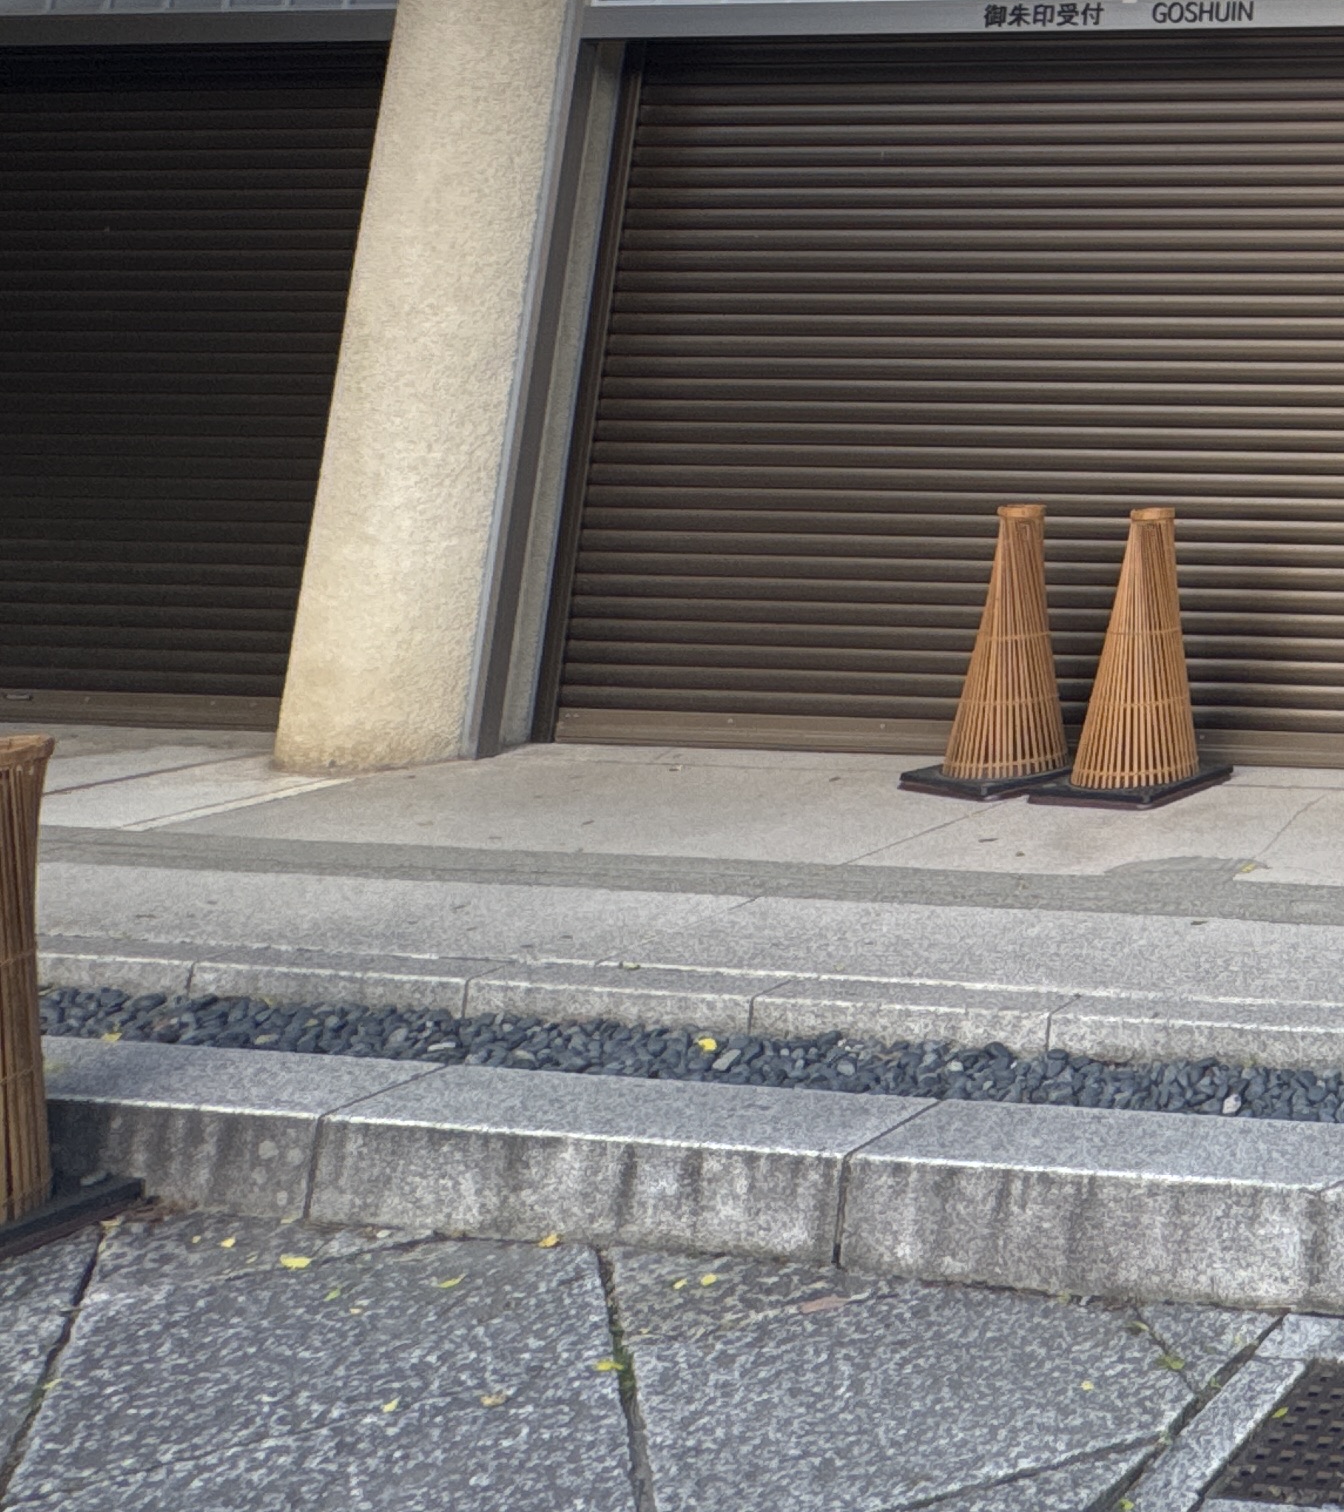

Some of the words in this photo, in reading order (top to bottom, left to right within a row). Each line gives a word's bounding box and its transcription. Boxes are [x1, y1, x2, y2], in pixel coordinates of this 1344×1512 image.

[983, 1, 1105, 28] 御朱印受付
[1152, 0, 1254, 24] GOSHUIN
